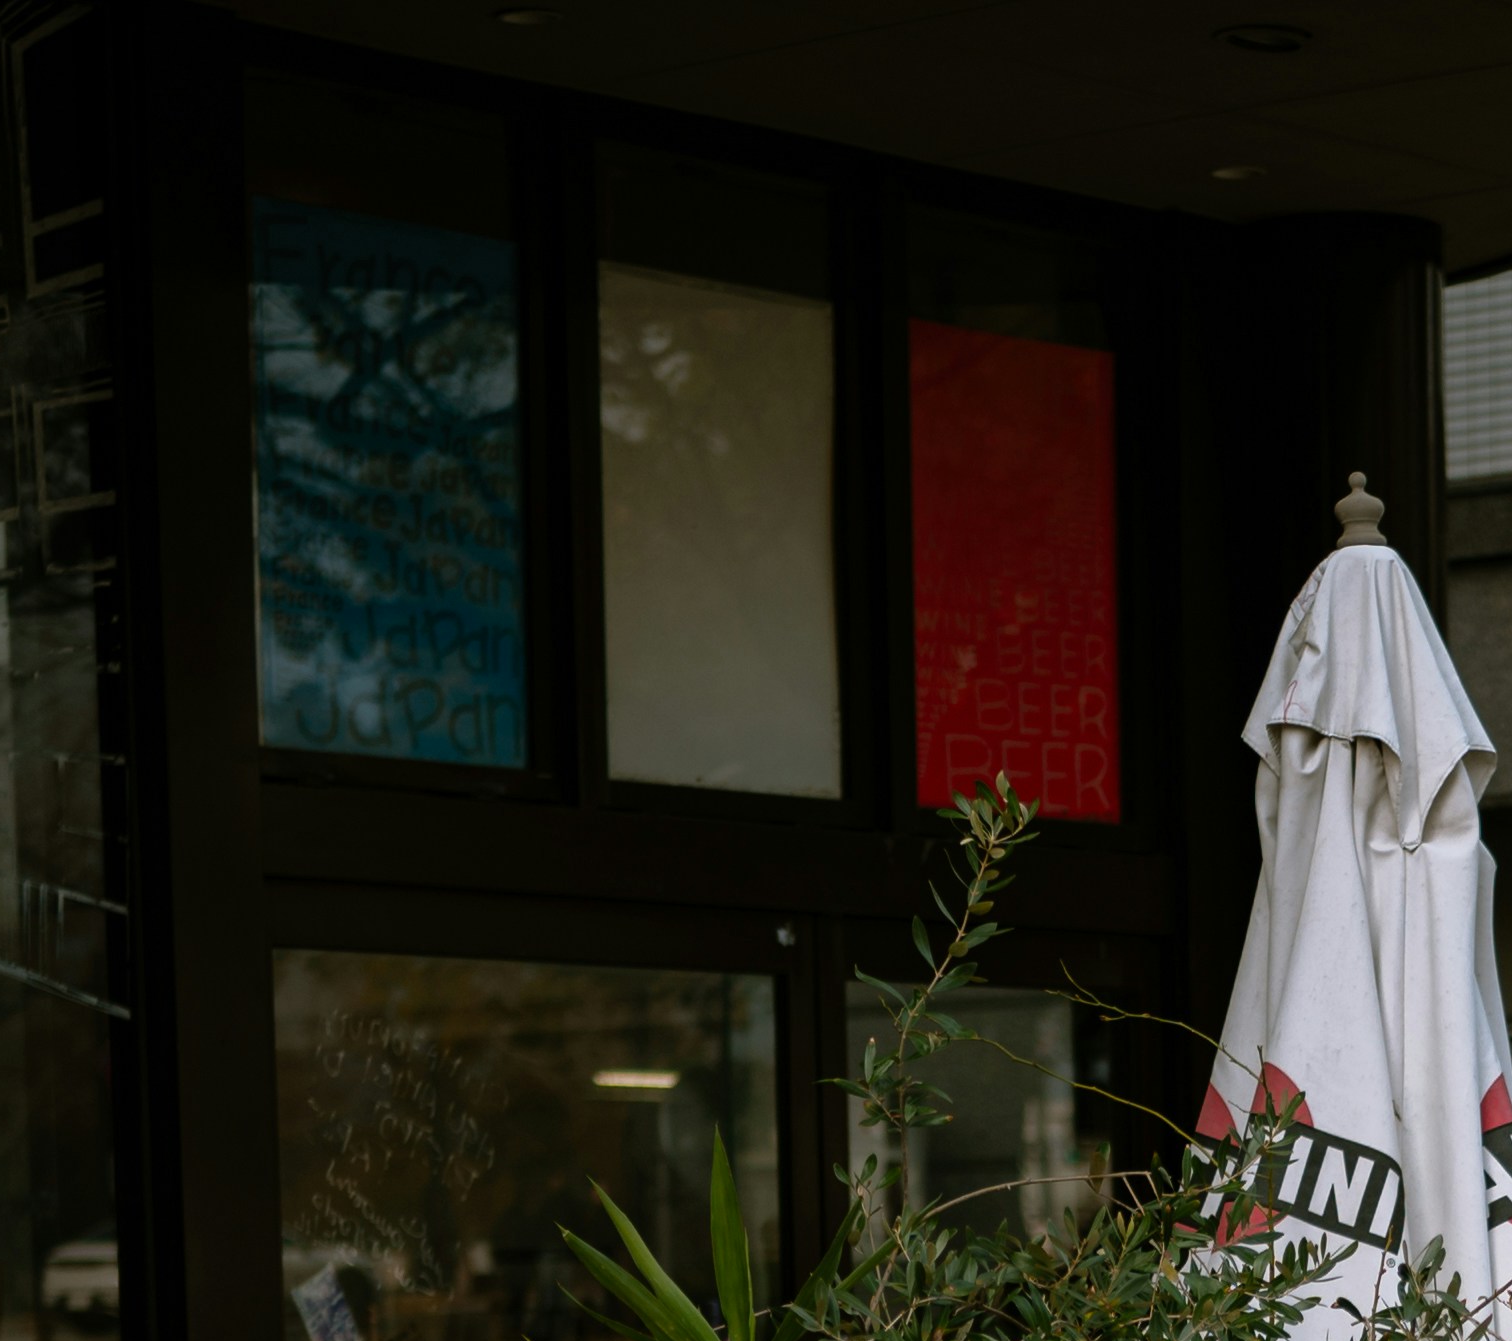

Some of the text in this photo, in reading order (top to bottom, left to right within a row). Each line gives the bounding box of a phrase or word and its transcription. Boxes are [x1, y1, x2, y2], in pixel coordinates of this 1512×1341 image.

[288, 676, 523, 758] Japan
[975, 678, 1109, 740] BEER
[944, 732, 1111, 813] BEER
